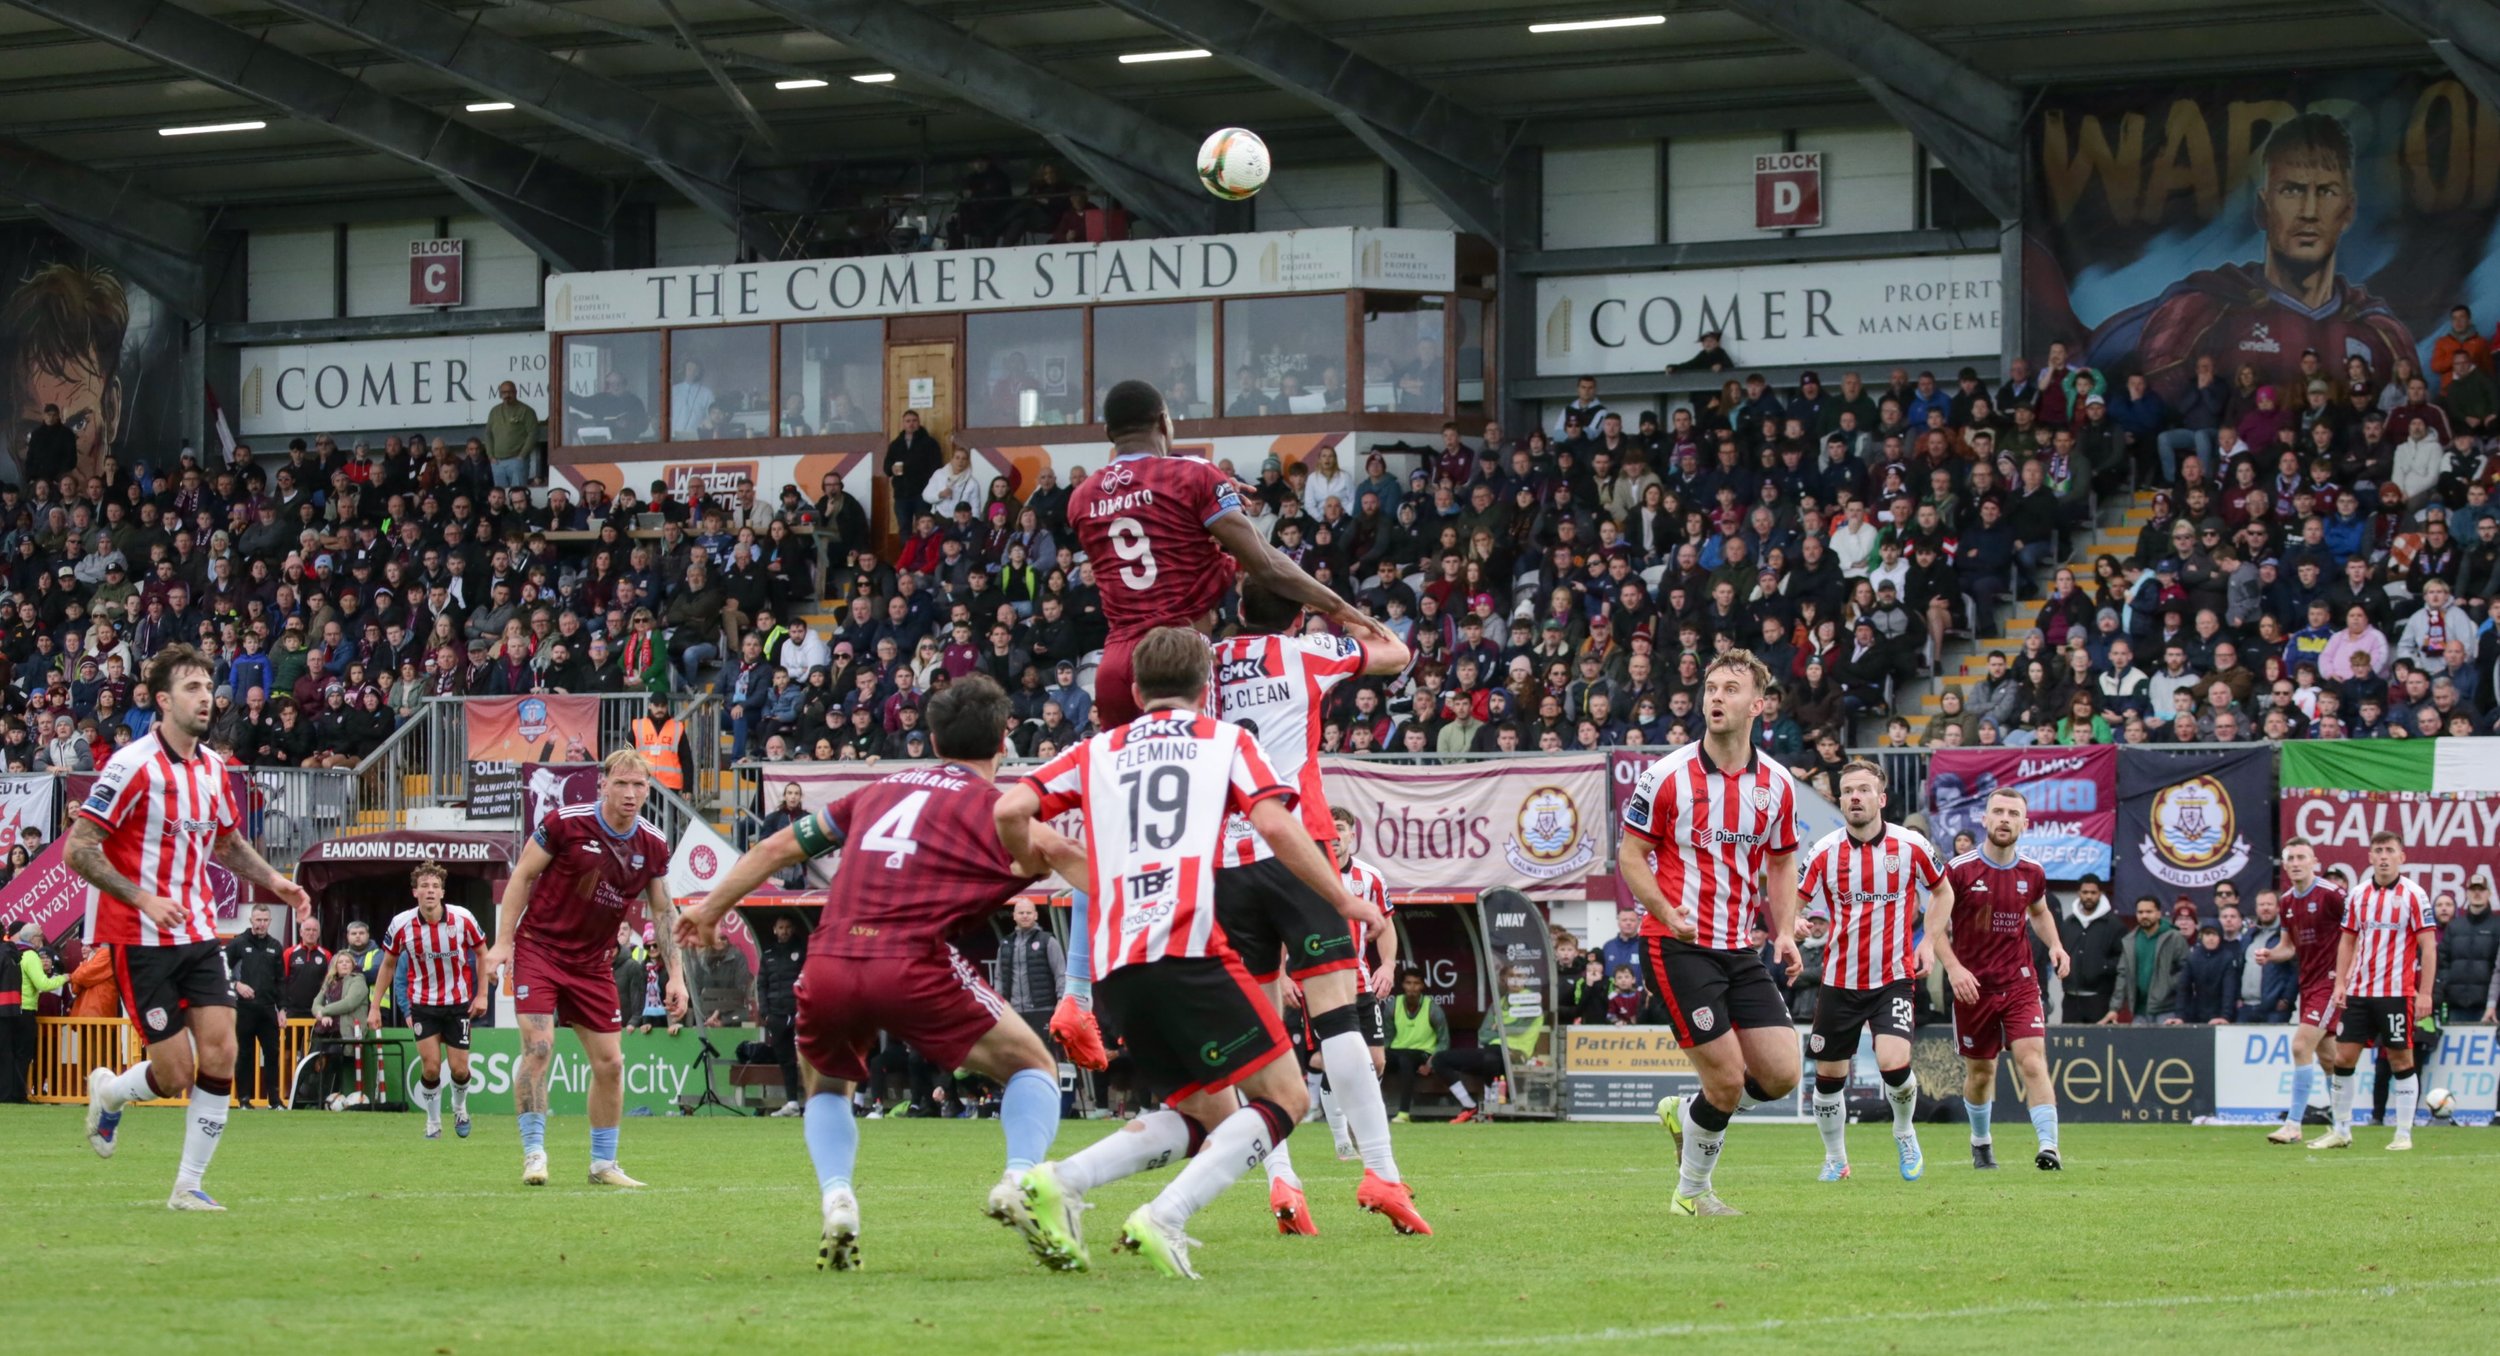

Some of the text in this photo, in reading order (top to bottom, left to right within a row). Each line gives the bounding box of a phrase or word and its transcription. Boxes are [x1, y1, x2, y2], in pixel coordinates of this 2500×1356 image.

[1755, 154, 1818, 171] BLOCK
[1774, 181, 1800, 214] D
[410, 239, 460, 254] BLOCK
[1384, 251, 1416, 259] COMER
[1281, 262, 1323, 271] PROPERTY
[1384, 262, 1428, 270] PROPERTY
[423, 264, 446, 293] C
[647, 242, 1238, 320] THE COMER STAND
[1281, 272, 1340, 281] MANAGEMENT
[1384, 271, 1447, 281] MANAGEMENT
[574, 312, 626, 320] MANAGEMENT
[1590, 288, 1843, 348] COMER
[1858, 311, 2000, 336] MANAGEME
[276, 359, 477, 411] COMER
[1108, 516, 1158, 590] 9
[1219, 658, 1257, 686] GMK
[1236, 681, 1290, 708] CLEAN
[1126, 719, 1184, 744] GMK
[1116, 742, 1198, 770] FLEMING
[2016, 757, 2087, 778] ALWAYS
[15, 781, 32, 795] FC
[475, 782, 503, 793] GALWAY
[473, 795, 493, 804] MORE
[471, 804, 511, 815] WILL KNOW
[1119, 765, 1190, 853] 19
[860, 790, 932, 869] 4
[1375, 801, 1490, 860] bháis
[2019, 820, 2083, 840] LWAYS
[322, 842, 490, 859] EAMONN DEACY PARK
[1512, 857, 1542, 874] GALWAY
[2160, 865, 2229, 885] AULD LADS
[1855, 892, 1900, 902] Diamond
[1495, 912, 1526, 928] AWAY
[428, 950, 459, 960] Diamond
[1892, 997, 1912, 1022] 23
[2387, 1013, 2406, 1033] 12
[1575, 1036, 1647, 1051] Patrick
[2053, 1036, 2085, 1048] THE
[1575, 1057, 1609, 1067] SALES
[547, 1053, 690, 1105] Airicity
[1814, 1103, 1841, 1113] ERRY
[2121, 1109, 2194, 1121] HOTEL
[2258, 1111, 2278, 1122] +35
